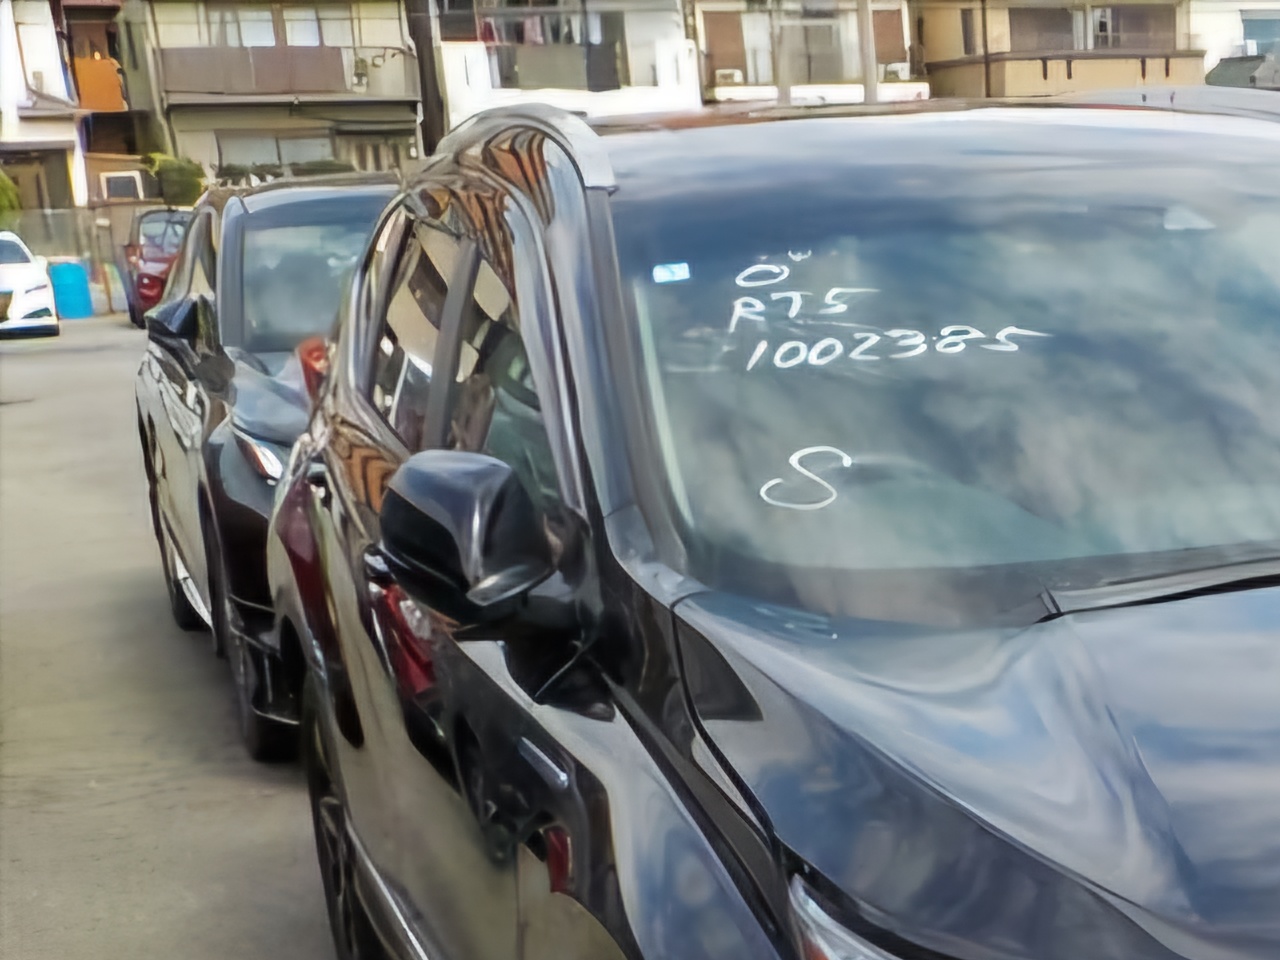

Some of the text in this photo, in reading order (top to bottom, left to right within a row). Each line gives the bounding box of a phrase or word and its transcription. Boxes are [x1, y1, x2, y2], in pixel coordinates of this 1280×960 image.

[728, 286, 880, 334] RT5
[745, 324, 1054, 372] 1002385
[759, 445, 853, 511] S
